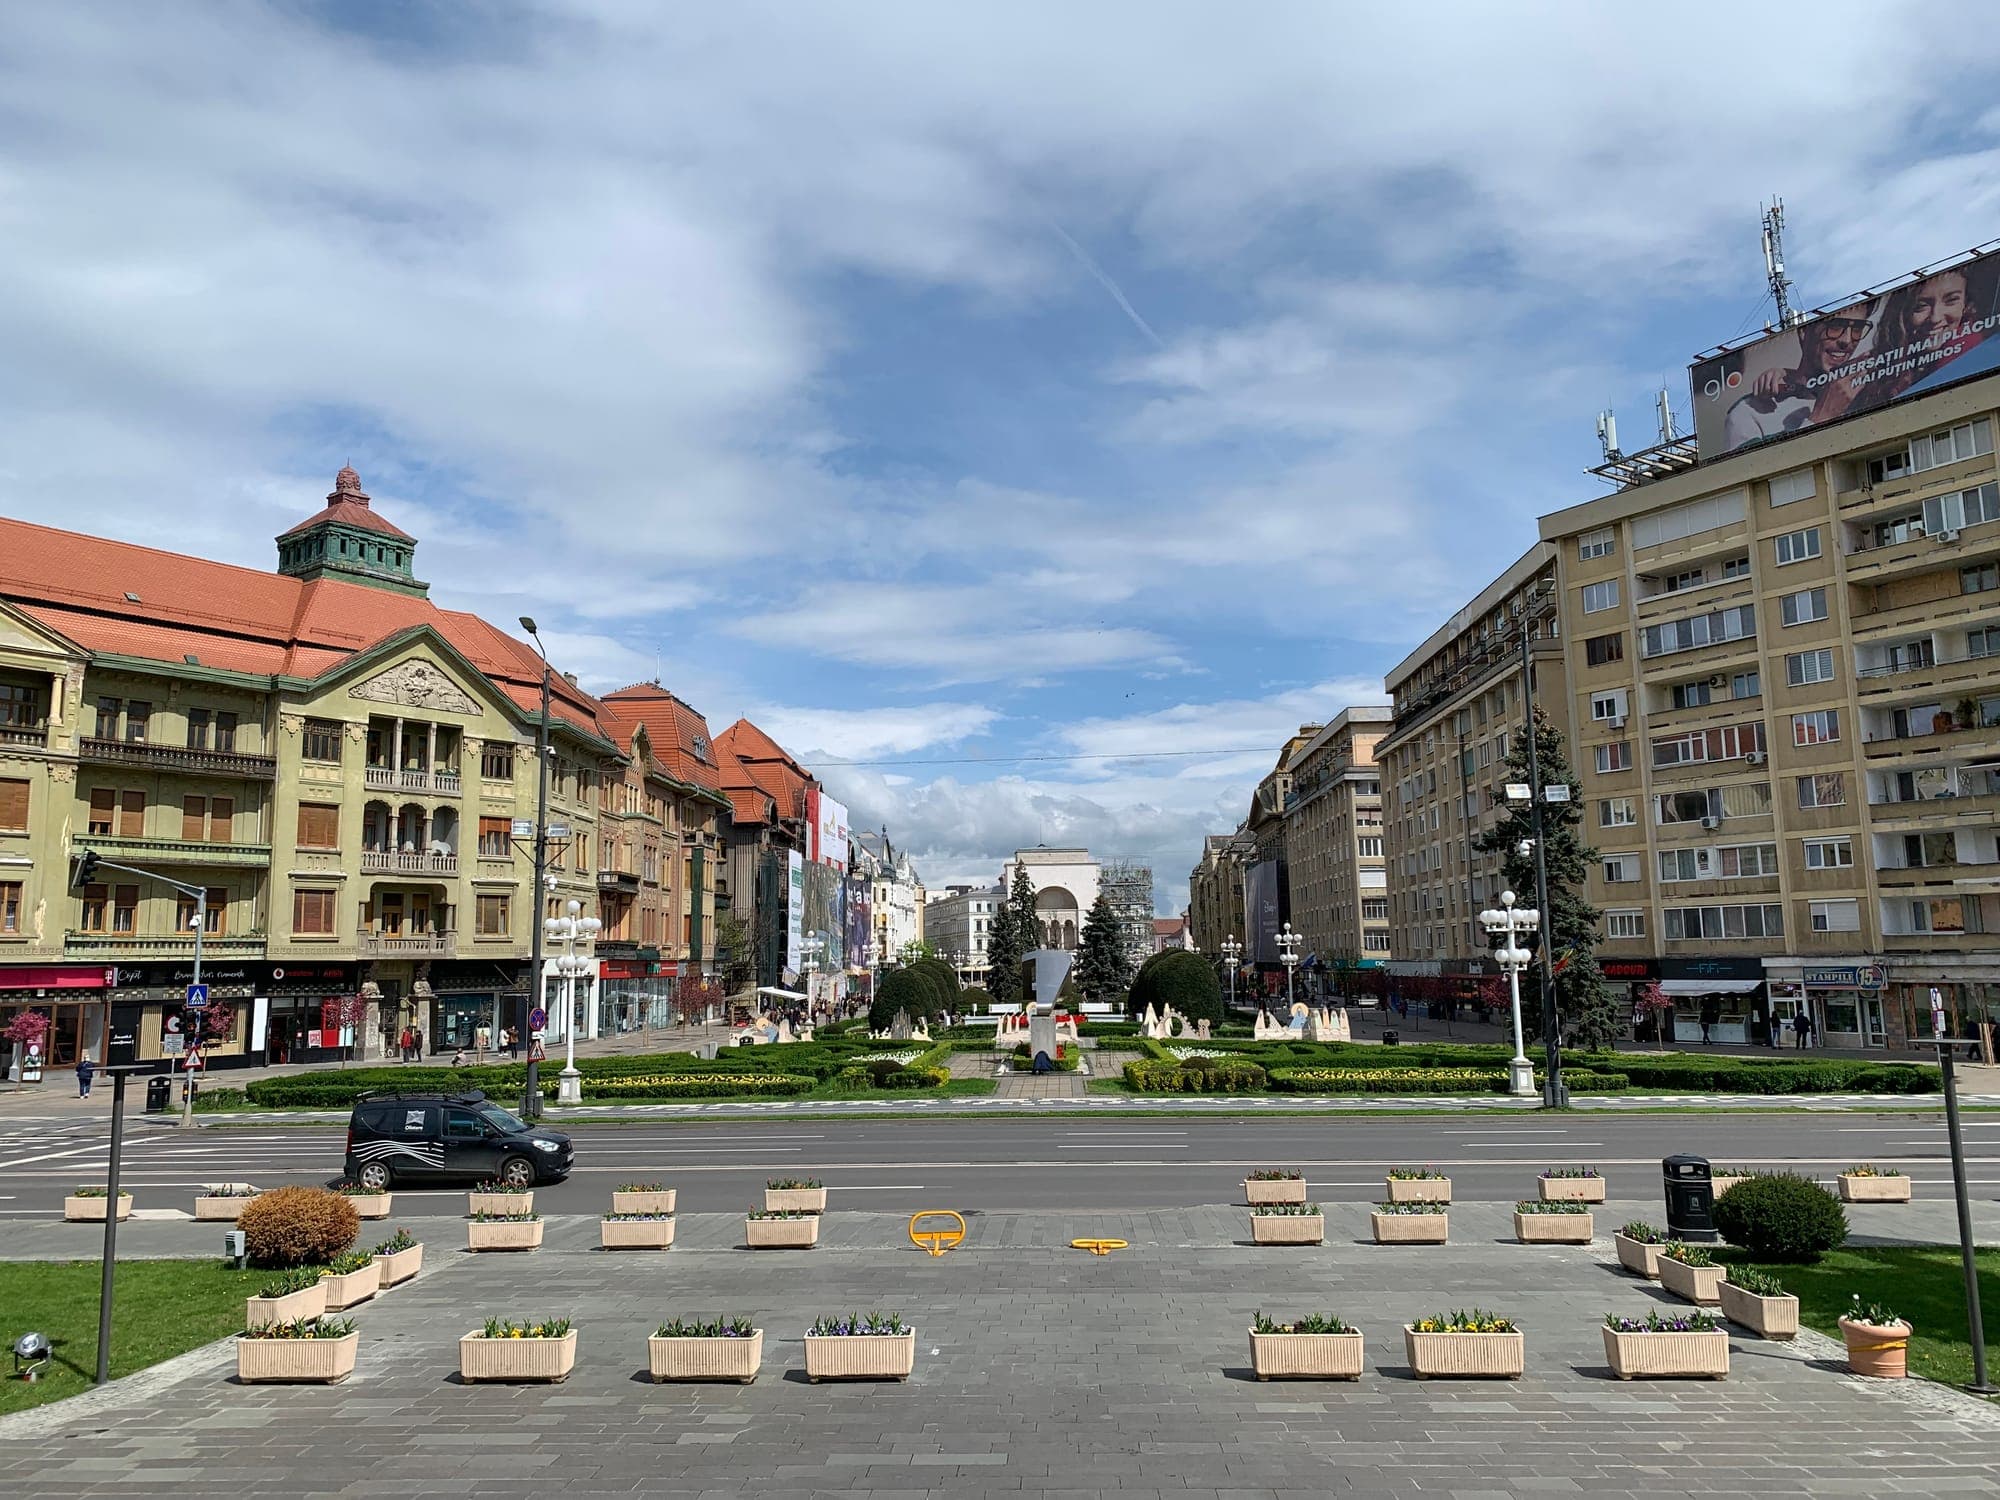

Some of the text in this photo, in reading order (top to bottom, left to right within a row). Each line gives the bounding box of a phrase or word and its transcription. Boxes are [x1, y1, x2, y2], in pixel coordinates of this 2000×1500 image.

[1806, 346, 1904, 389] CONVERSAȚII
[1907, 336, 1939, 355] MAI
[1851, 372, 1877, 389] MAI
[1878, 358, 1917, 379] PUȚIN
[1704, 365, 1743, 401] glo
[1805, 972, 1854, 982] STAMPILE
[1859, 968, 1874, 986] 15
